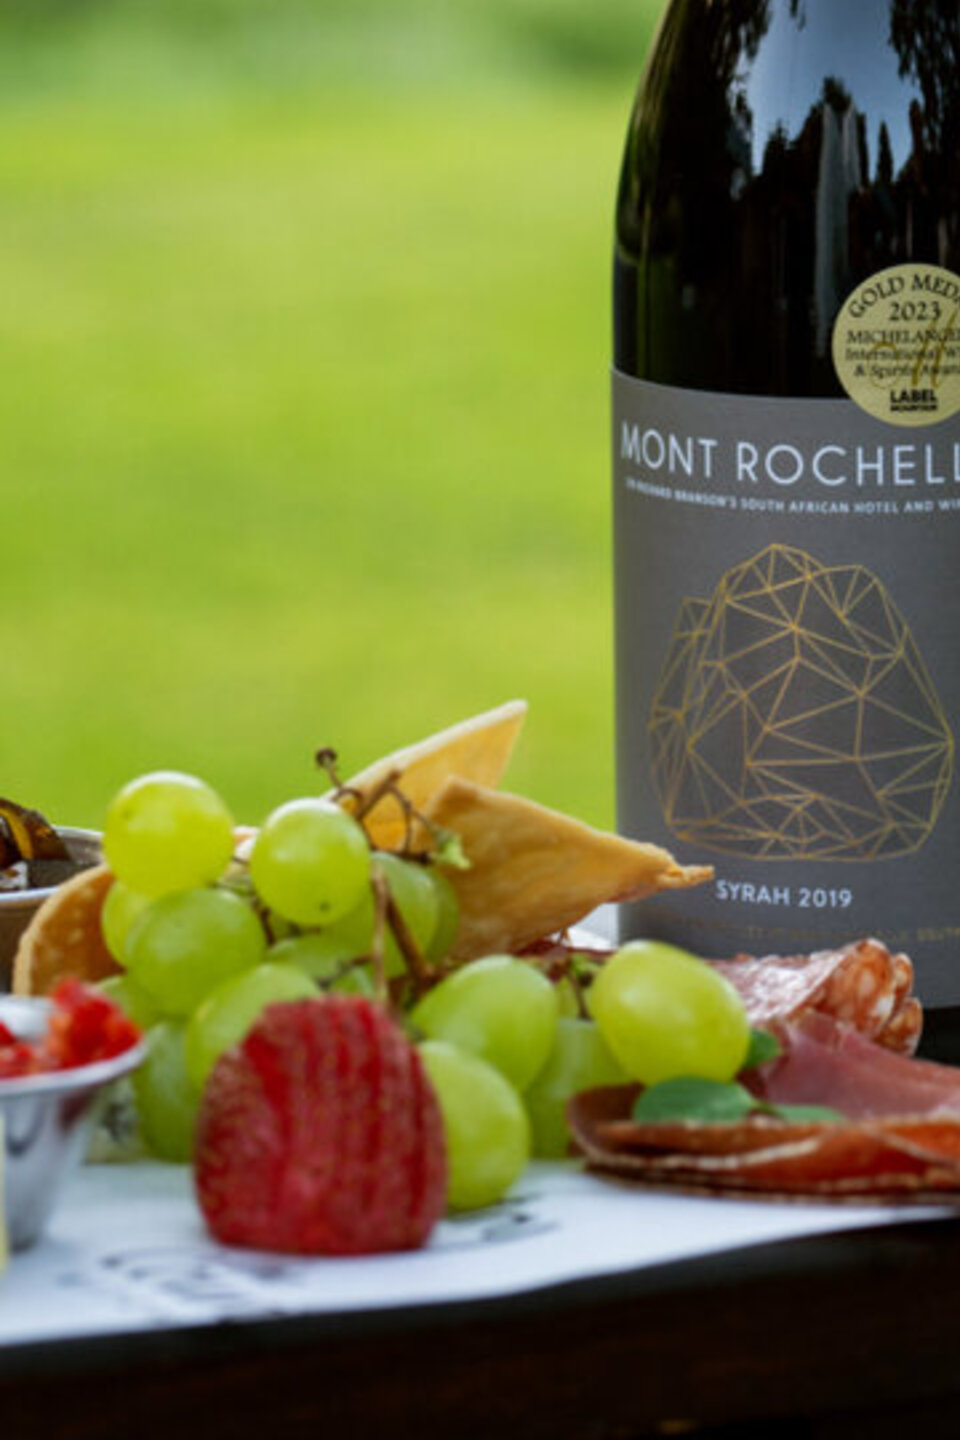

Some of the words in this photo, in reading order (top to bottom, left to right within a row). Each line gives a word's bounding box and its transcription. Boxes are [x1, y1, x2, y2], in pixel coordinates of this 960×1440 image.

[850, 276, 904, 318] GOLD
[889, 301, 940, 321] 2023
[890, 389, 937, 403] LABEL
[620, 420, 718, 479] MONT
[741, 498, 785, 511] SOUTH
[789, 499, 849, 513] AFRICAN
[854, 500, 900, 514] HOTEL
[903, 499, 934, 513] AND
[716, 879, 790, 906] SYRAH
[799, 887, 853, 908] 2019
